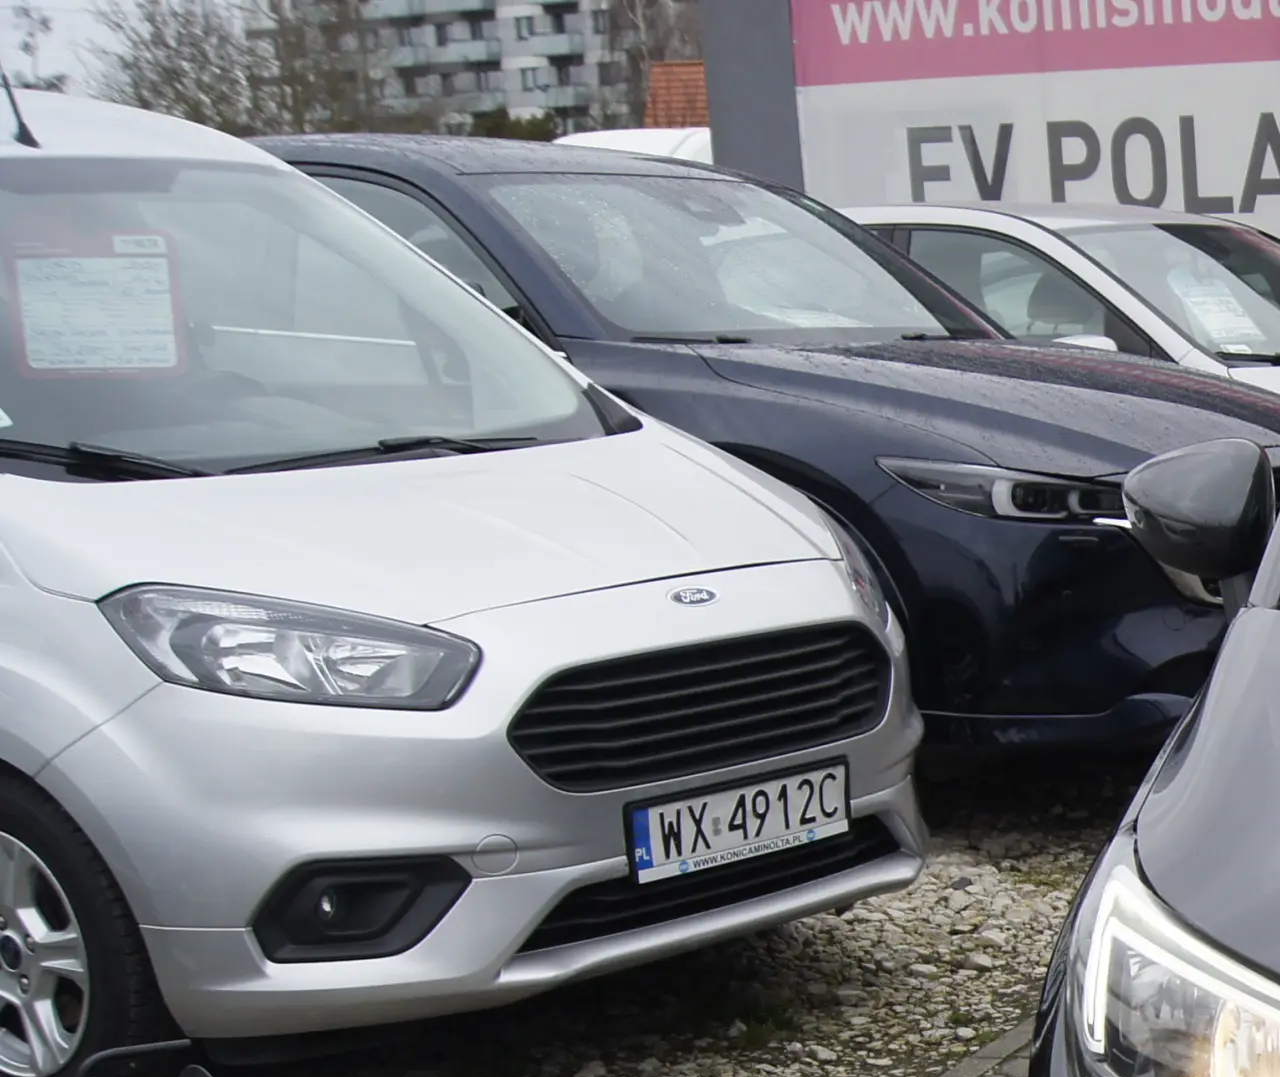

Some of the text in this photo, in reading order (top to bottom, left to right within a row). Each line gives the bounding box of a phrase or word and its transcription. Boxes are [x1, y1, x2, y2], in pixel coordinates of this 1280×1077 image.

[907, 122, 1014, 203] FV
[680, 589, 709, 603] Ford
[659, 772, 839, 860] WX 4912C
[635, 848, 650, 862] PL
[692, 837, 803, 869] WWW.KONICAMINOLTA.PL
